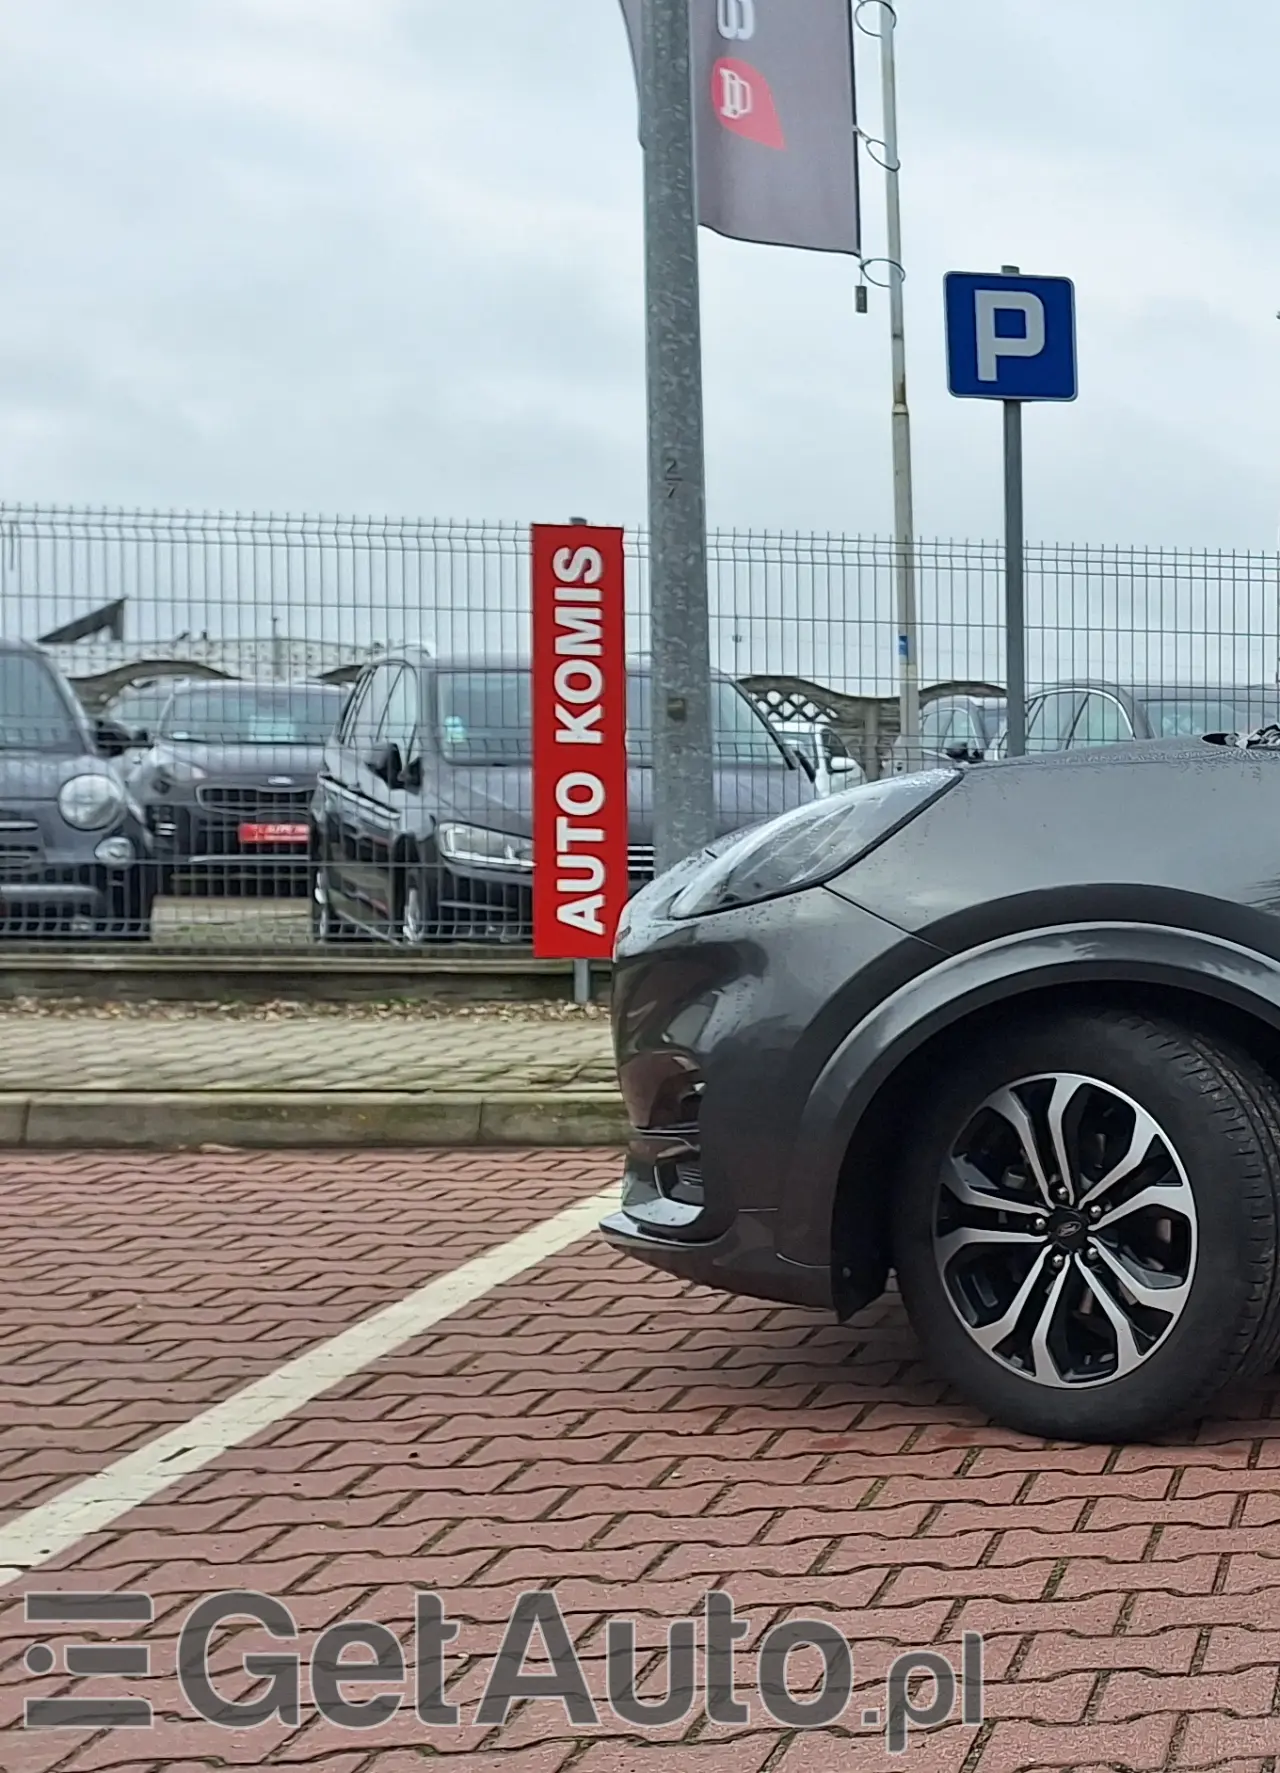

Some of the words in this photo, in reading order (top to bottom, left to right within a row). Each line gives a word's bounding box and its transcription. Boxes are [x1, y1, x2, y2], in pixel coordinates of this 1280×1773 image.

[974, 289, 1045, 382] P
[552, 545, 605, 744] KOMIS
[555, 770, 606, 935] AUTO
